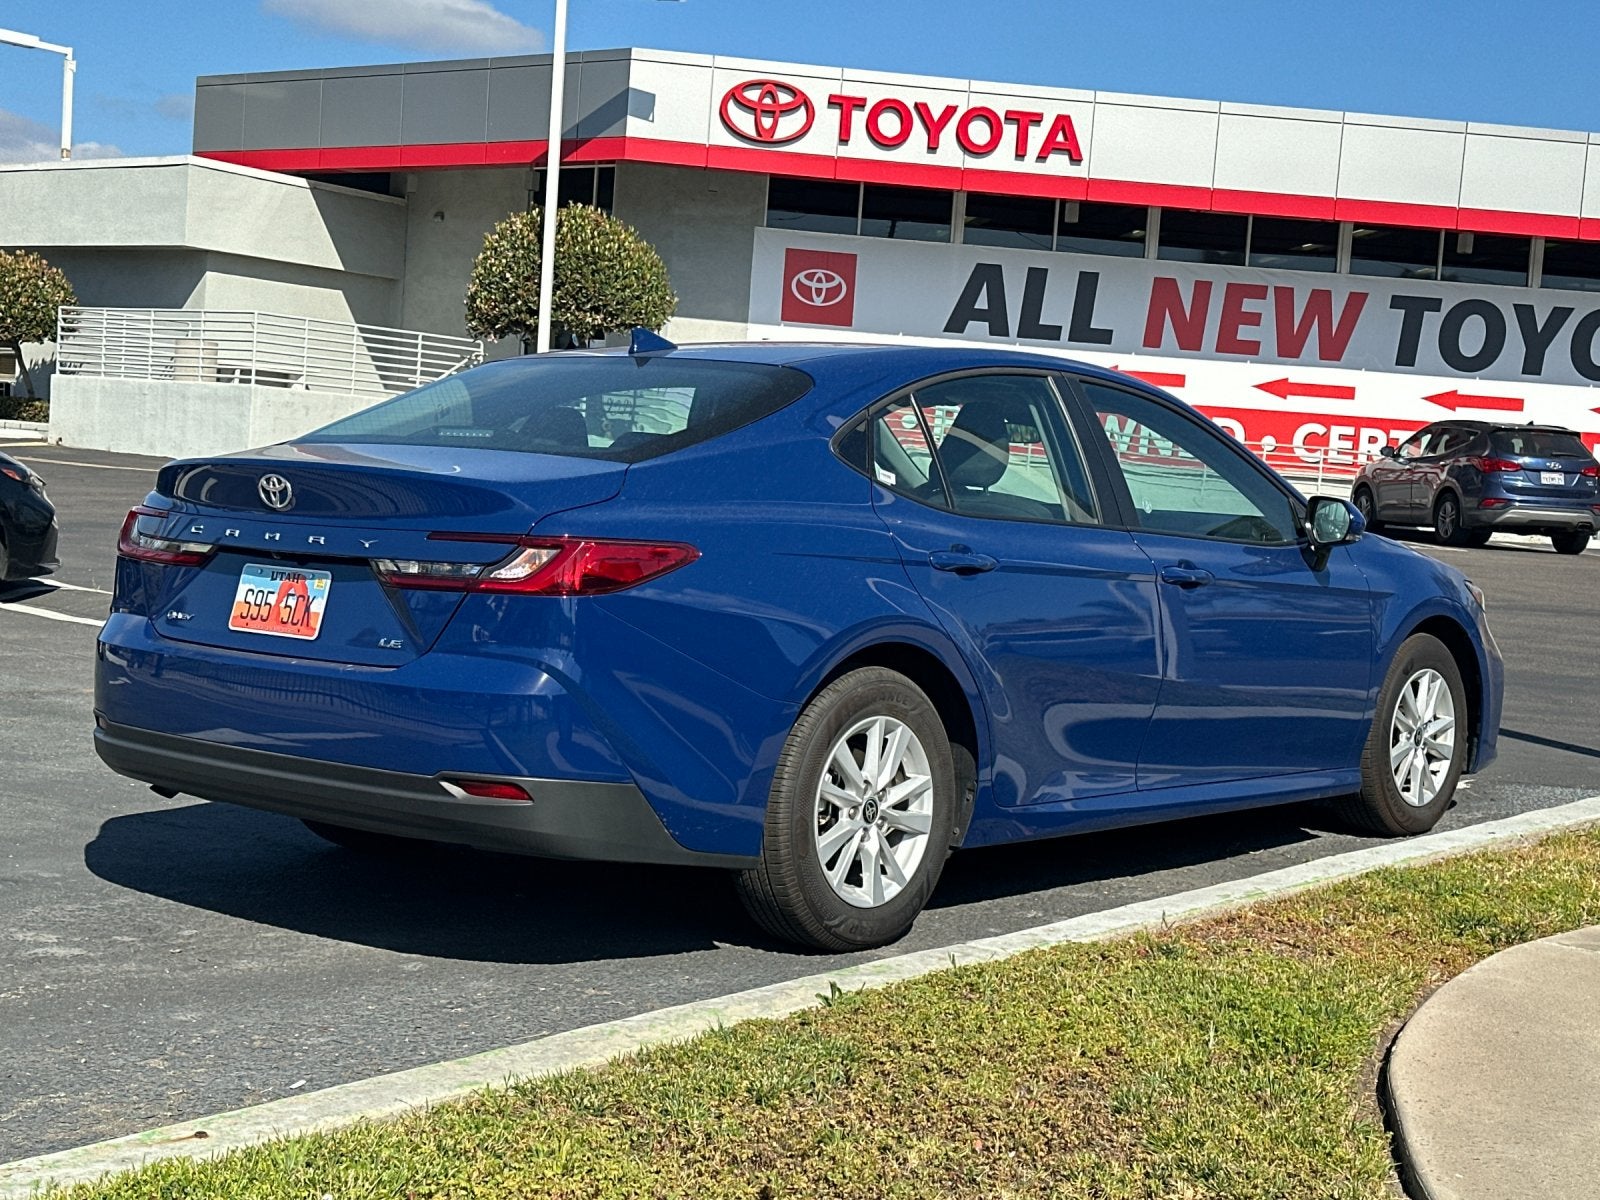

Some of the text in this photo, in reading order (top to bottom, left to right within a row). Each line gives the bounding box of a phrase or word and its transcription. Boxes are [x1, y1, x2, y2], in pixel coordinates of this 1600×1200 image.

[828, 94, 1084, 164] TOYOTA
[943, 262, 1113, 345] ALL
[1142, 276, 1369, 362] NEW
[190, 524, 379, 549] CAMRY
[270, 571, 301, 584] UTAH
[240, 588, 316, 628] S95 5CK
[378, 637, 404, 649] LE
